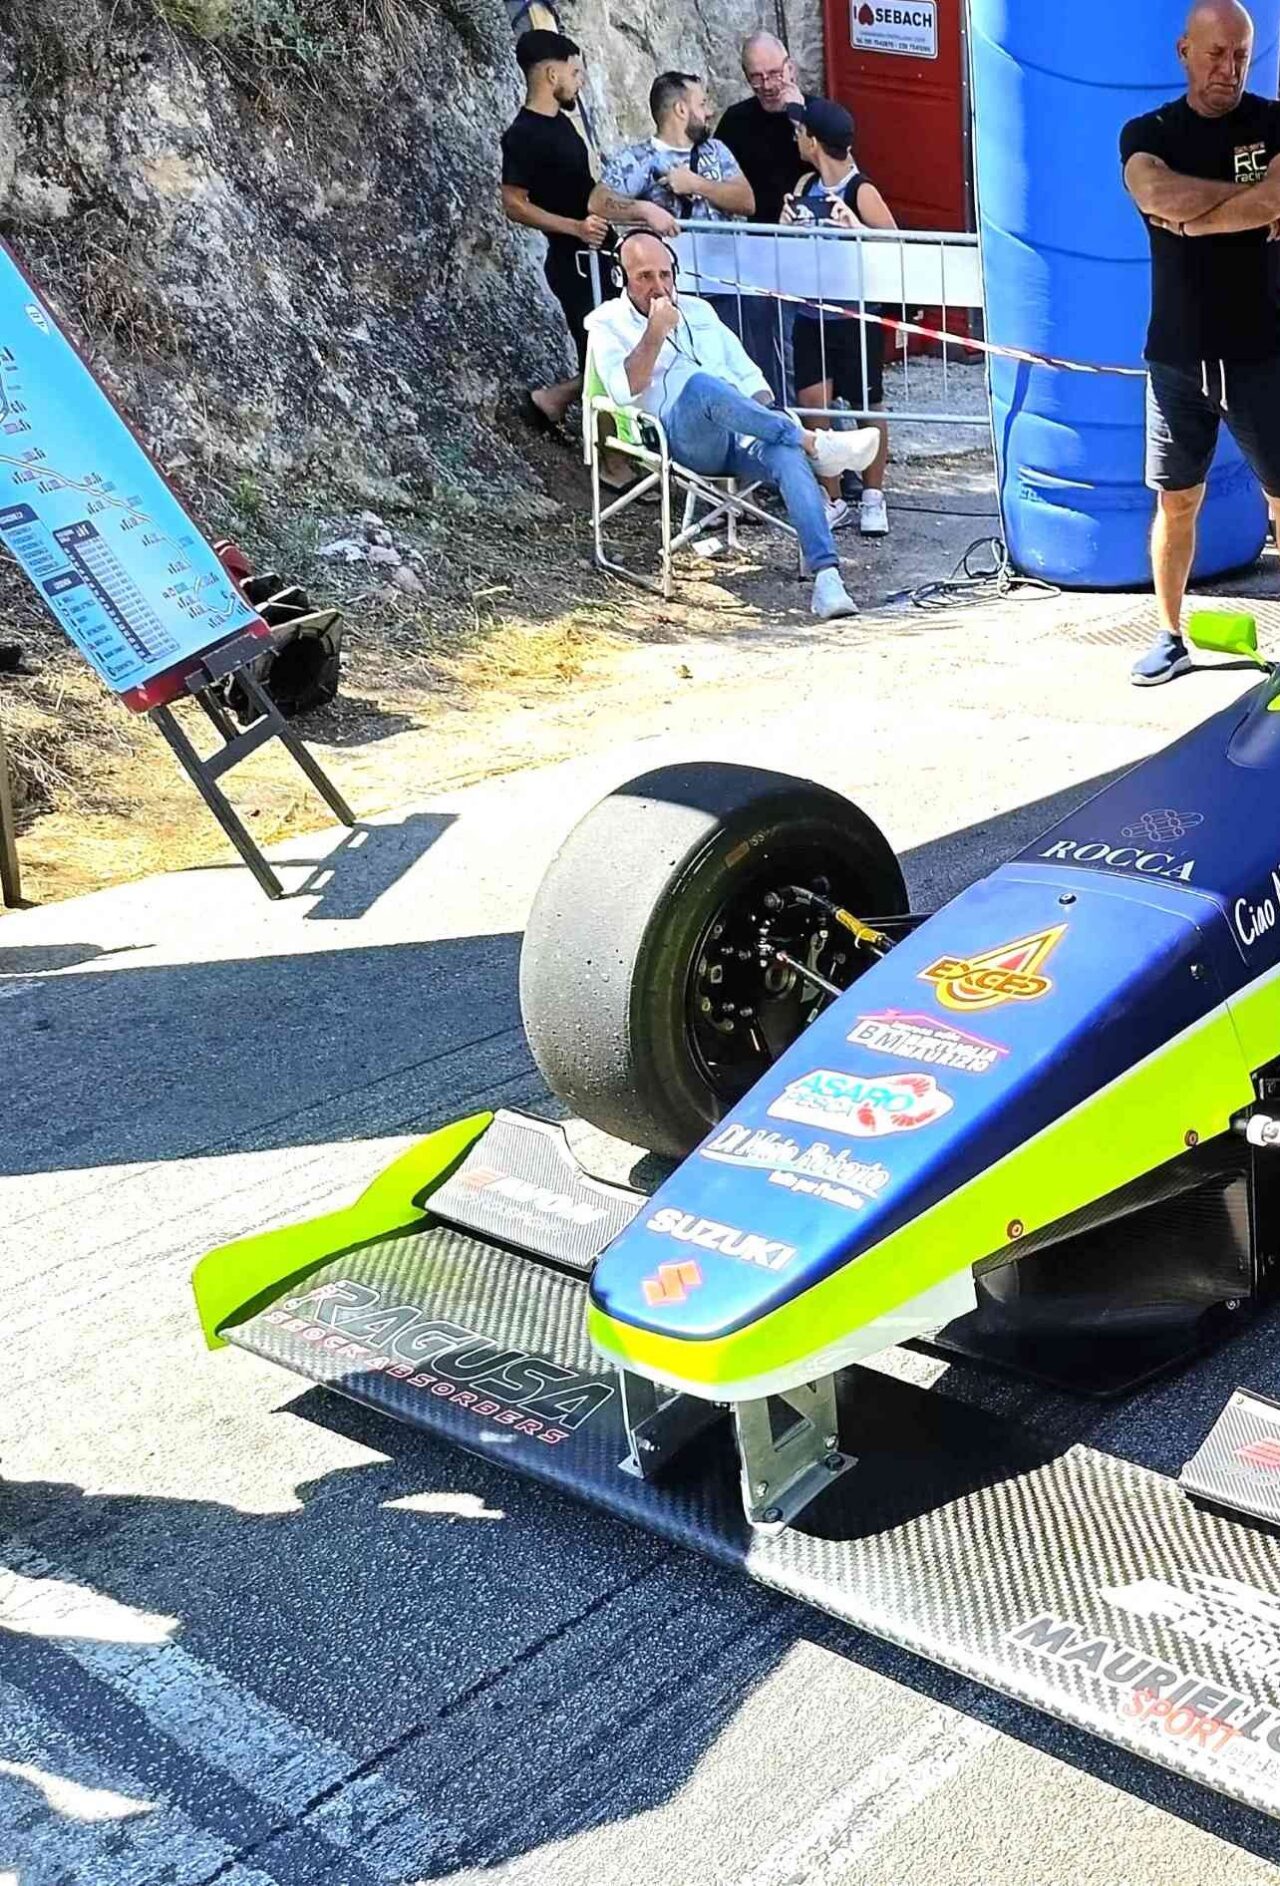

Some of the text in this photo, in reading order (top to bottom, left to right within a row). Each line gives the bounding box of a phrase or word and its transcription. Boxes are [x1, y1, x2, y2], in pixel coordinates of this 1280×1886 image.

[875, 8, 932, 28] SEBACH
[1234, 149, 1267, 173] RC
[1038, 839, 1196, 881] ROCCA
[1234, 896, 1275, 946] Ciao
[796, 1075, 914, 1112] ASARO
[646, 1206, 798, 1272] SUZUKI
[264, 1310, 571, 1445] SHOCK ABSORBERS
[314, 1279, 615, 1431] RAGUSA
[1122, 1686, 1244, 1756] SPORT
